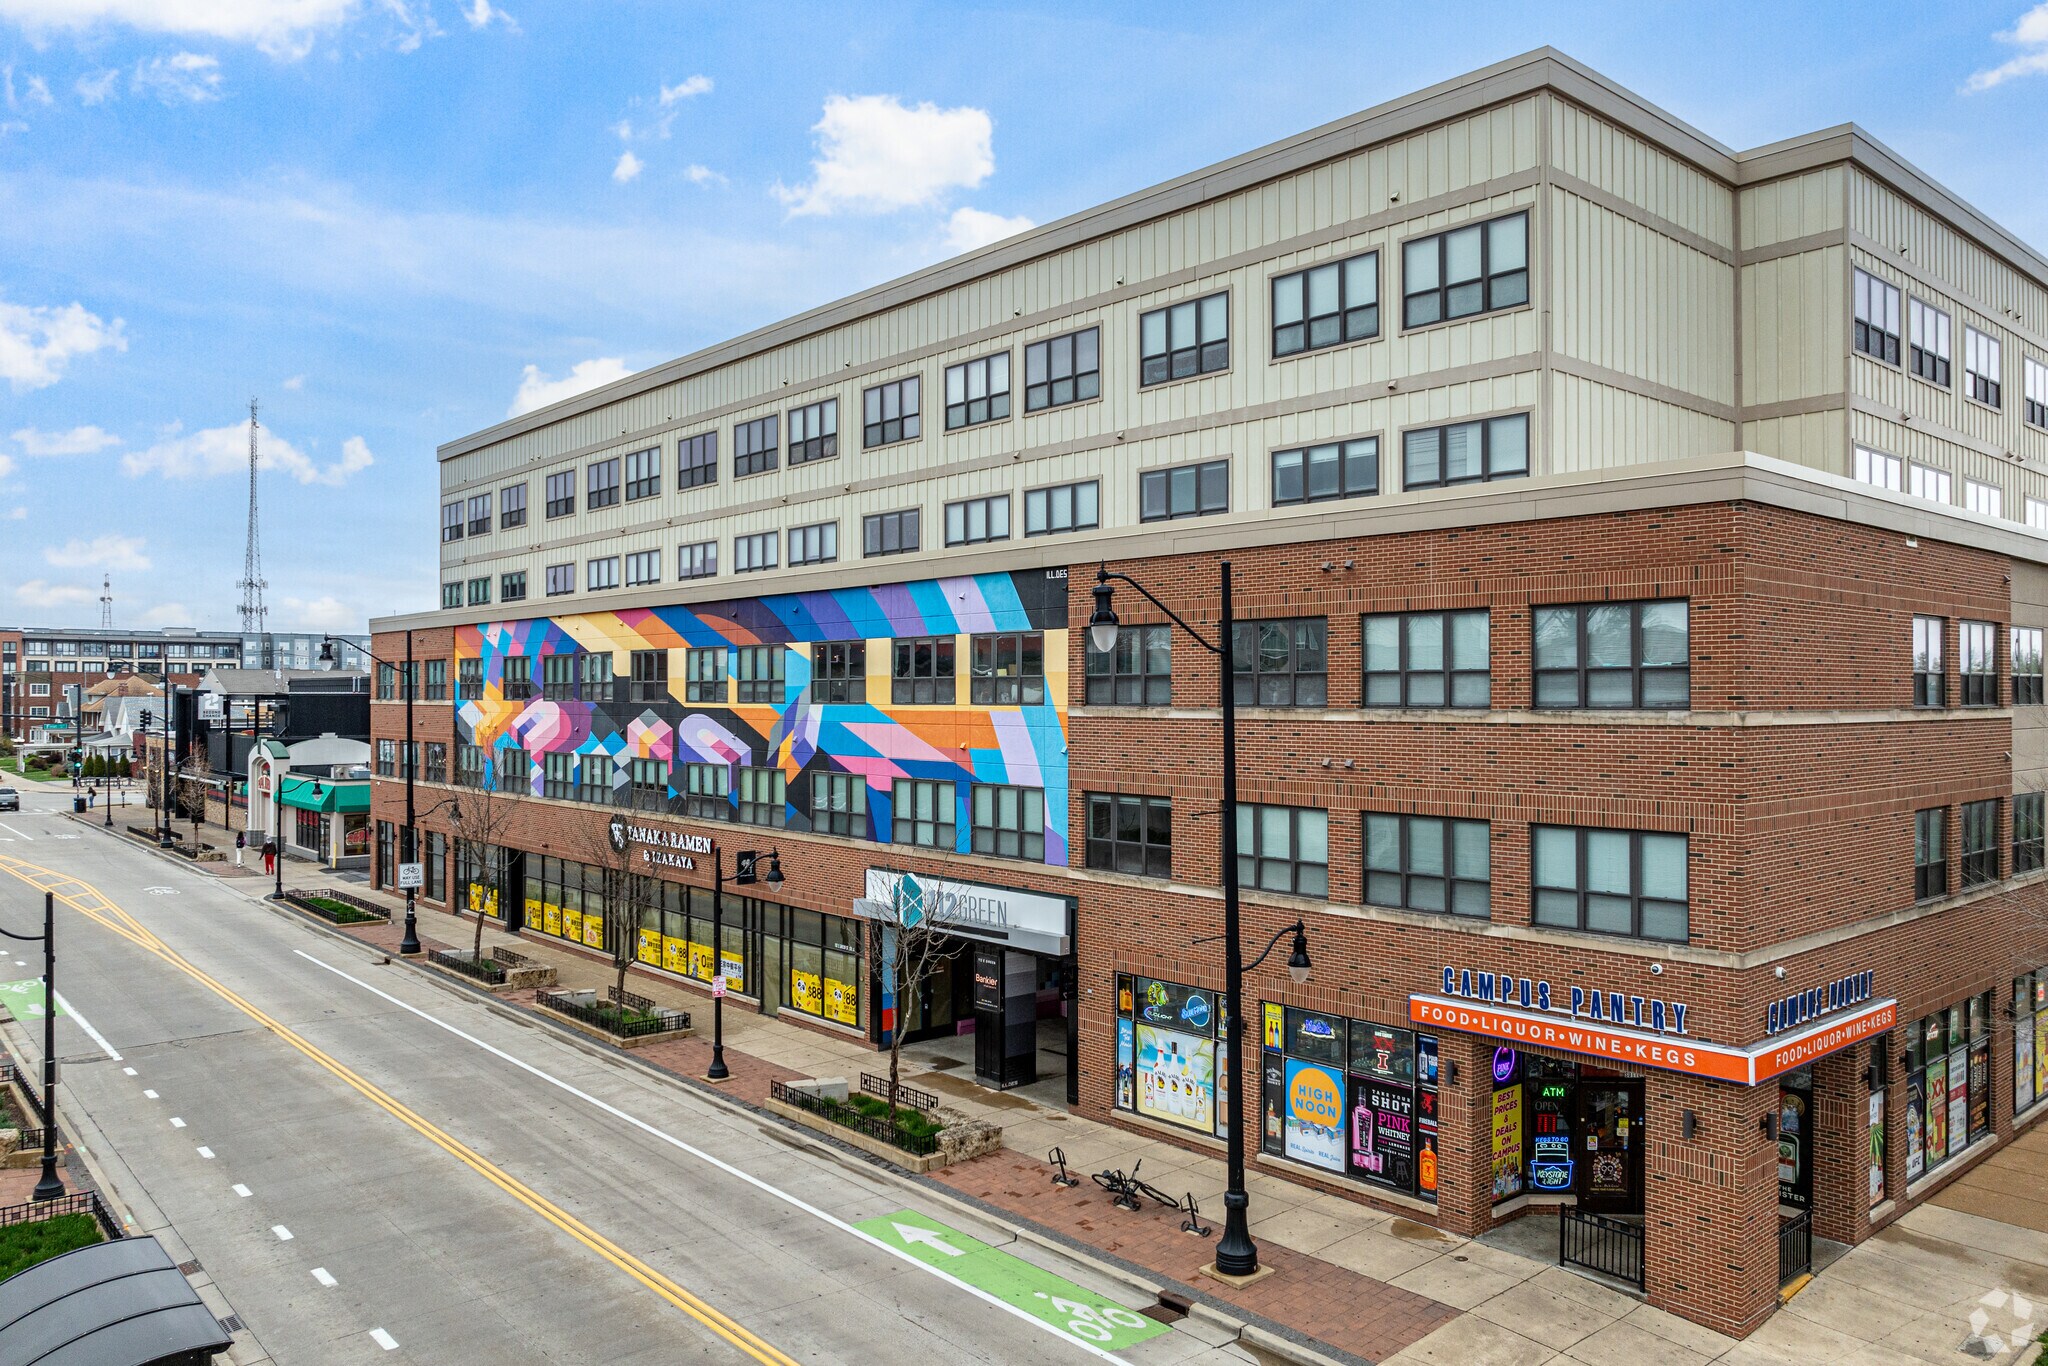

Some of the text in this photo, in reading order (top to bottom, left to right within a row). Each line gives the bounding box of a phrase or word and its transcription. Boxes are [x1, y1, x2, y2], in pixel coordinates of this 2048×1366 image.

[627, 825, 712, 854] TANAKA RAMEN
[652, 851, 694, 870] IZAKAYA
[975, 973, 998, 986] Bankier
[808, 986, 822, 1000] $88
[1443, 966, 1687, 1034] CAMPUS PANTRY
[1768, 986, 1823, 1034] CAMPUS
[1298, 1084, 1333, 1103] HIGH
[1371, 1088, 1411, 1103] TAKE YOUR
[1497, 1089, 1515, 1103] BEST
[1542, 1087, 1564, 1097] ATM
[1295, 1097, 1337, 1118] NOON
[1371, 1094, 1411, 1114] SHOT
[1494, 1099, 1518, 1116] PRICES
[1535, 1100, 1559, 1111] OPEN
[1377, 1111, 1411, 1133] PINK
[1504, 1114, 1509, 1123] &
[1377, 1126, 1411, 1141] WHITNEY
[1495, 1121, 1518, 1138] DEALS
[1501, 1134, 1512, 1146] ON
[1492, 1142, 1520, 1161] CAMPUS
[1537, 1168, 1569, 1179] KEYSTONE
